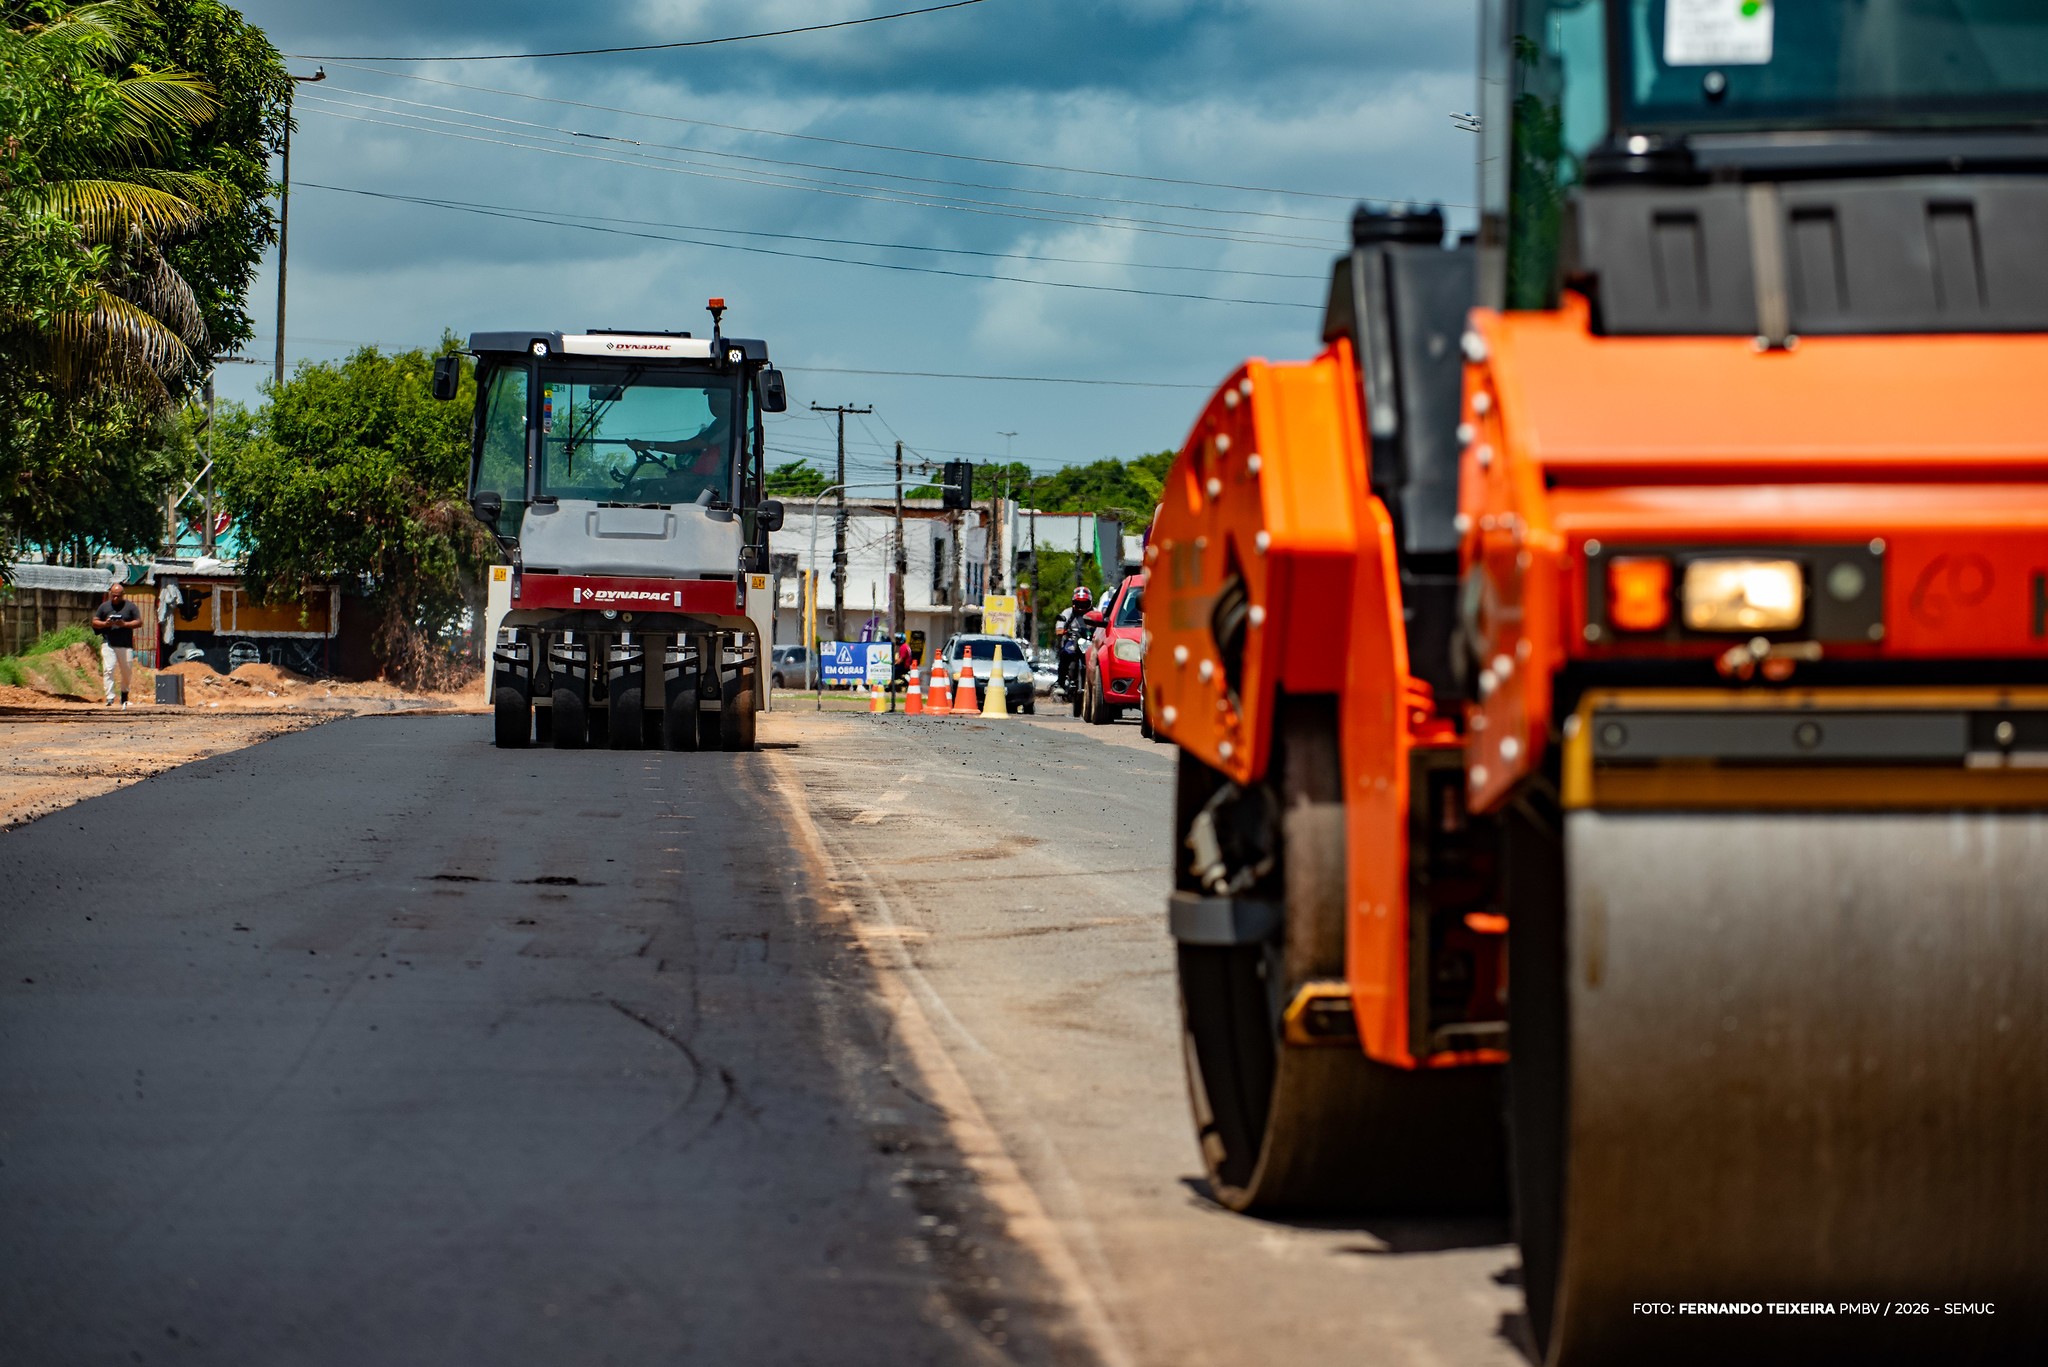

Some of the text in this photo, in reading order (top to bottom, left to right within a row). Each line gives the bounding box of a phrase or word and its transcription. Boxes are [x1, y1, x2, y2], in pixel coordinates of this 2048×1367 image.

[616, 343, 671, 351] DYNAPAC
[595, 590, 671, 601] DYNAPAC
[825, 665, 864, 675] EM OBRAS
